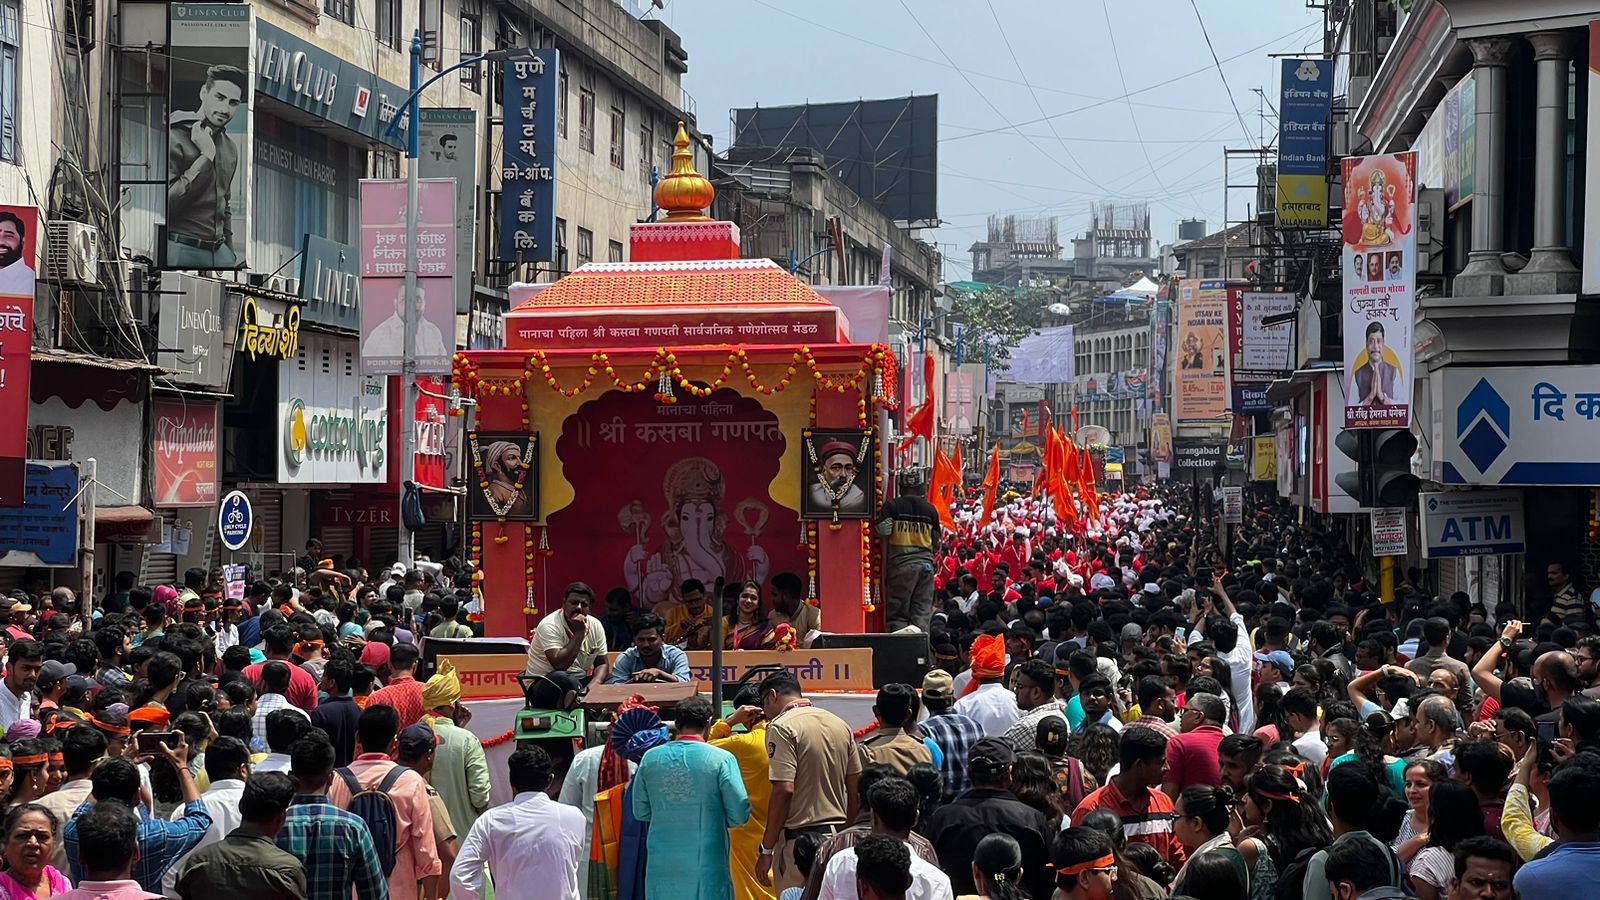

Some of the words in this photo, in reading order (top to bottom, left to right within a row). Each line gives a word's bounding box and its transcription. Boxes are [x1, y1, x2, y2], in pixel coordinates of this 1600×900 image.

[514, 56, 545, 79] पुणे
[269, 146, 293, 170] FINEST
[294, 154, 314, 178] LINEN
[314, 161, 337, 187] FABRIC
[1281, 153, 1305, 161] Indian
[1306, 153, 1326, 161] Bank
[514, 230, 538, 249] लि.
[518, 329, 554, 339] मानाचा
[558, 326, 588, 340] पहिला
[593, 325, 605, 338] श्री
[609, 327, 640, 338] कसबा
[644, 323, 680, 337] गणपती
[683, 322, 734, 336] सार्वजनिक
[737, 321, 788, 335] गणेशोत्सव
[793, 321, 818, 334] मंडळ
[656, 404, 696, 416] मानाचा
[701, 401, 733, 416] पहिला
[1531, 382, 1567, 421] दि
[599, 416, 626, 443] श्री
[635, 421, 703, 443] कसबा
[1178, 458, 1216, 467] Collection
[1441, 515, 1511, 542] ATM
[1469, 546, 1493, 554] HOURS
